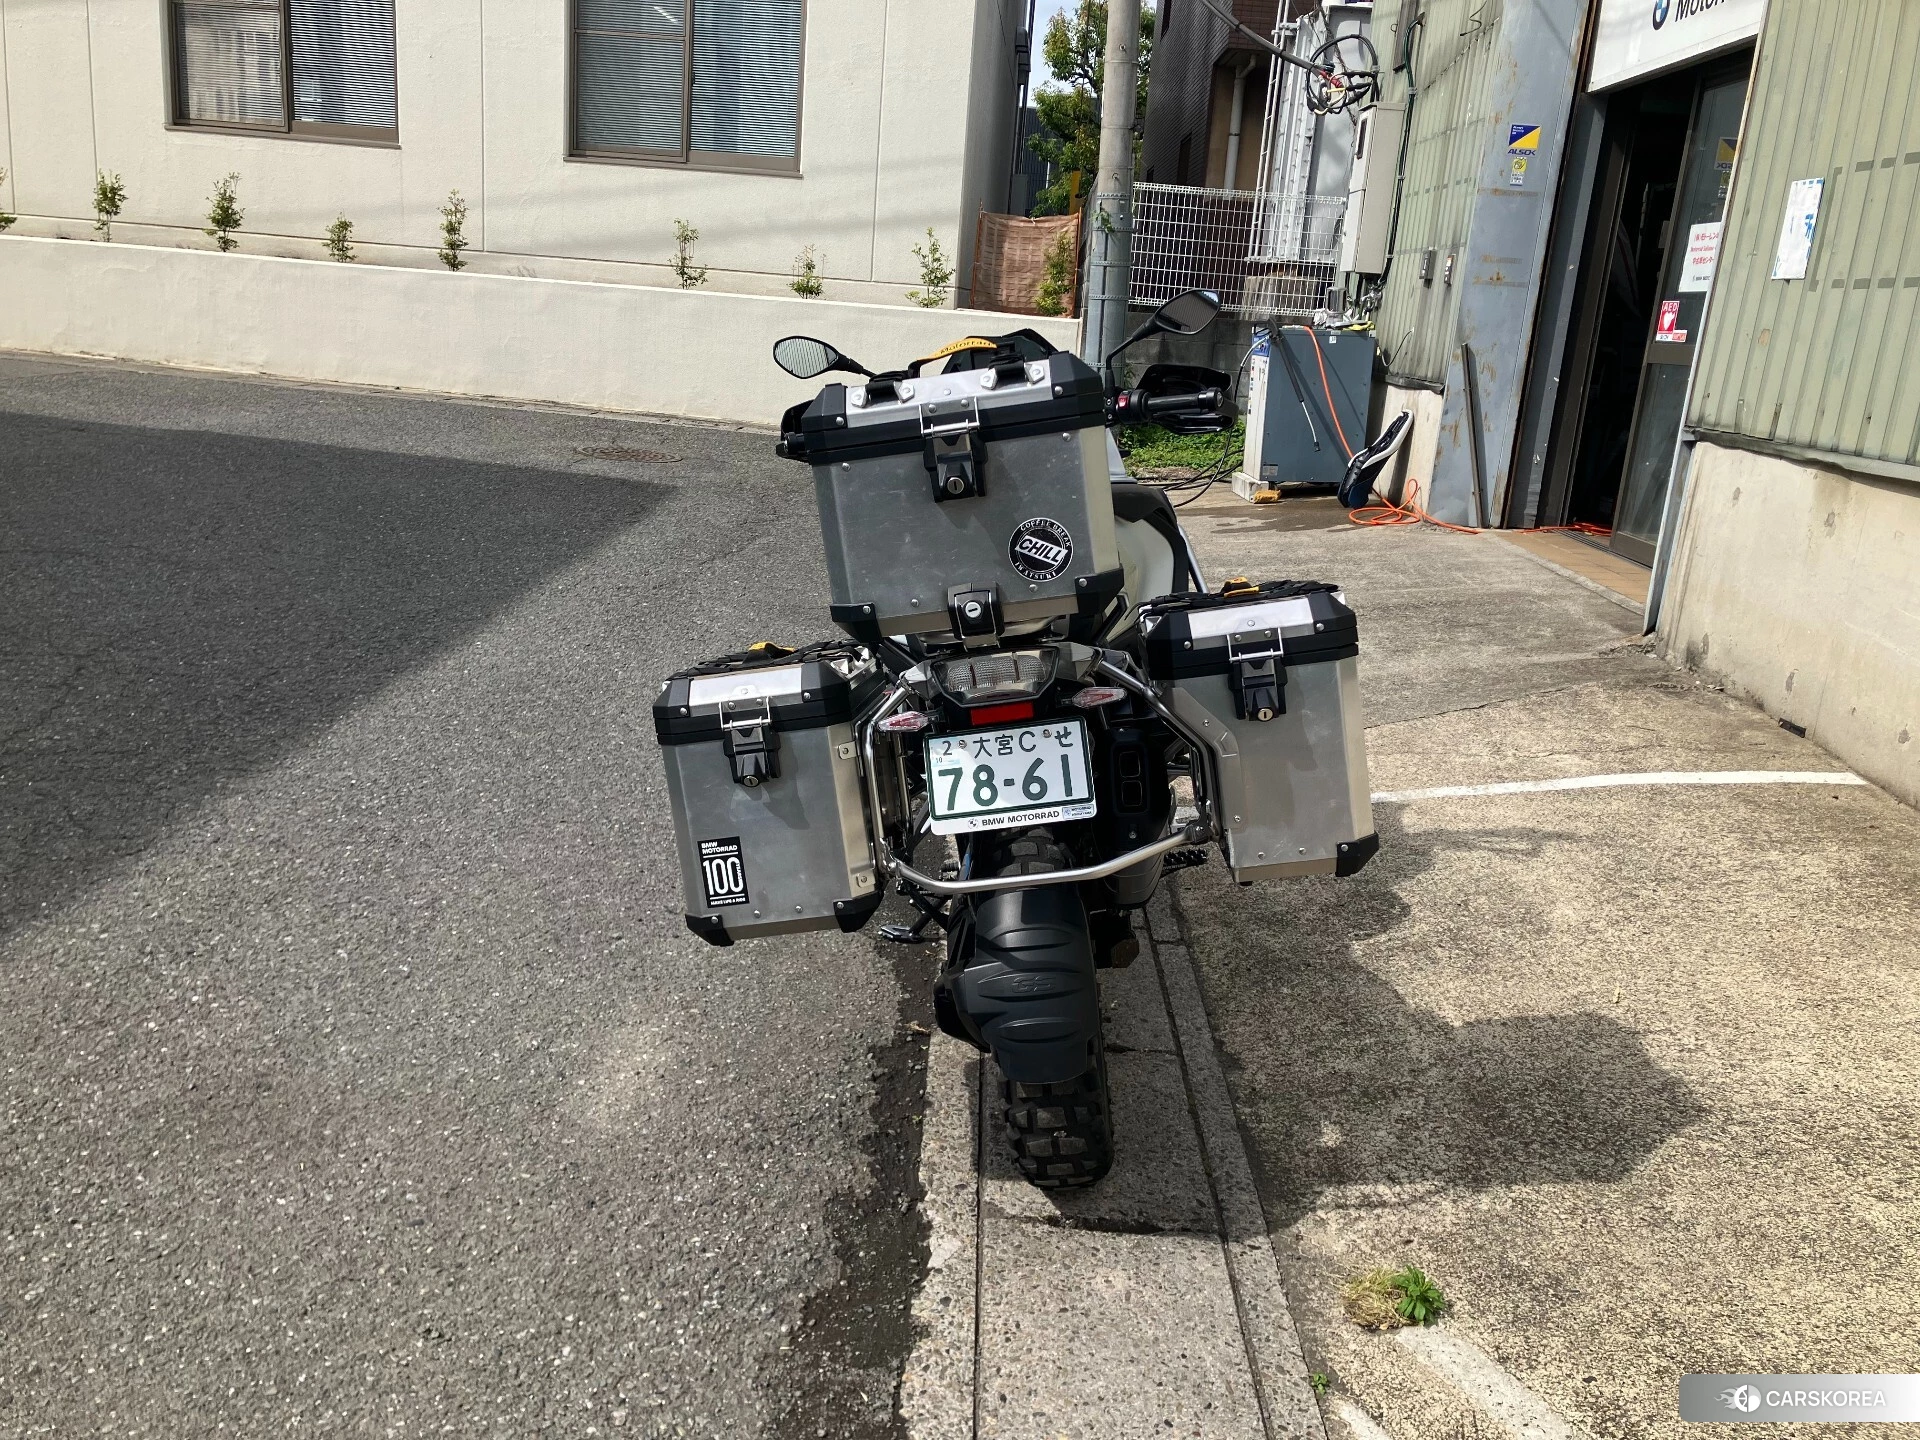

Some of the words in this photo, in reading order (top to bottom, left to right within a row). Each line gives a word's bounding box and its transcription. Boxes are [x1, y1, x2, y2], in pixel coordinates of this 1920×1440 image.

[1508, 148, 1536, 156] ALSOK
[1662, 302, 1678, 311] AED
[1020, 519, 1052, 531] COFFEE
[1052, 524, 1071, 547] BREAK
[1019, 538, 1062, 563] CHILL
[942, 740, 952, 756] 2
[973, 730, 1036, 759] 大宮C
[1054, 726, 1073, 748] せ
[938, 754, 1073, 811] 78-61
[981, 817, 1005, 827] BMW
[1007, 810, 1060, 823] MOTORRAD
[702, 845, 738, 854] MOTORRAD
[703, 857, 744, 895] 100
